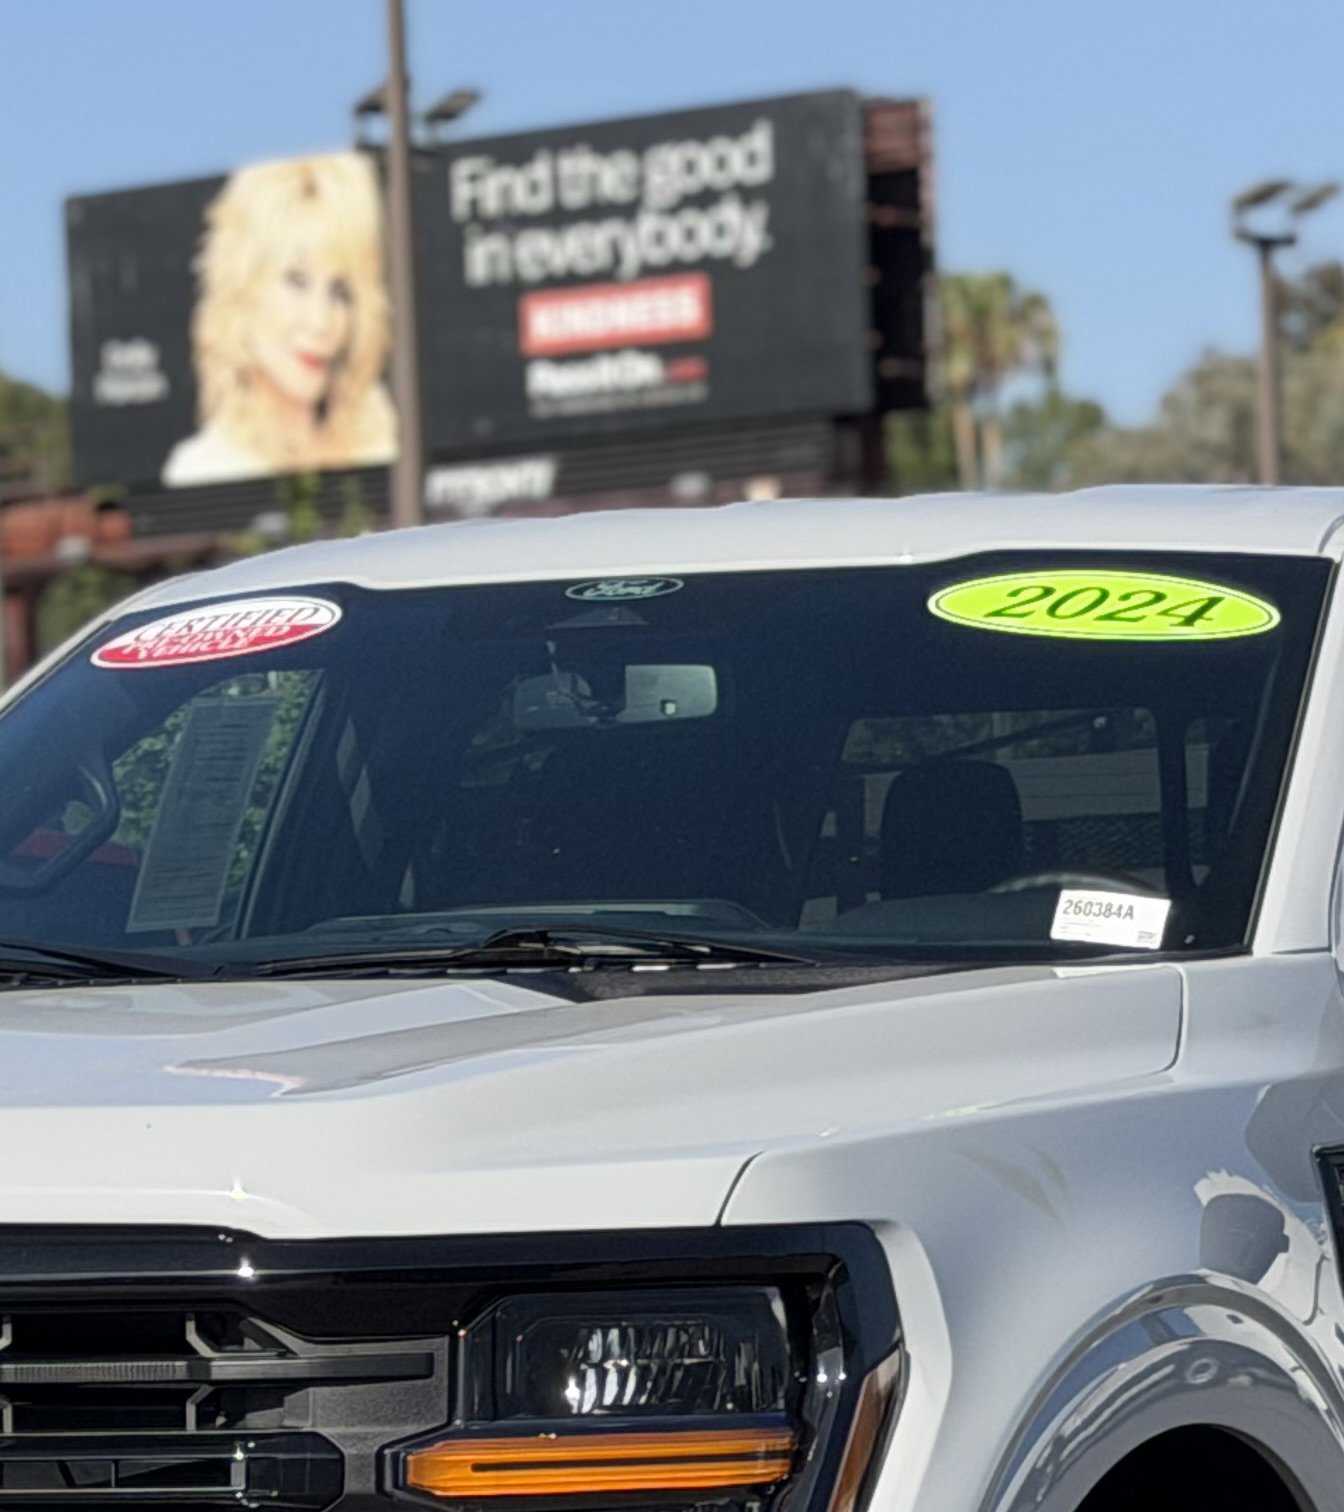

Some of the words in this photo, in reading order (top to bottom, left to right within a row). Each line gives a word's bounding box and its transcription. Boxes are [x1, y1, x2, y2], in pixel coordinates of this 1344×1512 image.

[449, 150, 553, 224] Find
[555, 144, 640, 208] the
[642, 119, 774, 210] good
[463, 222, 513, 286] in
[514, 193, 772, 280] everybody.
[135, 606, 321, 642] CERTIFIED
[983, 585, 1226, 628] 2024
[1062, 898, 1135, 921] 260384A
